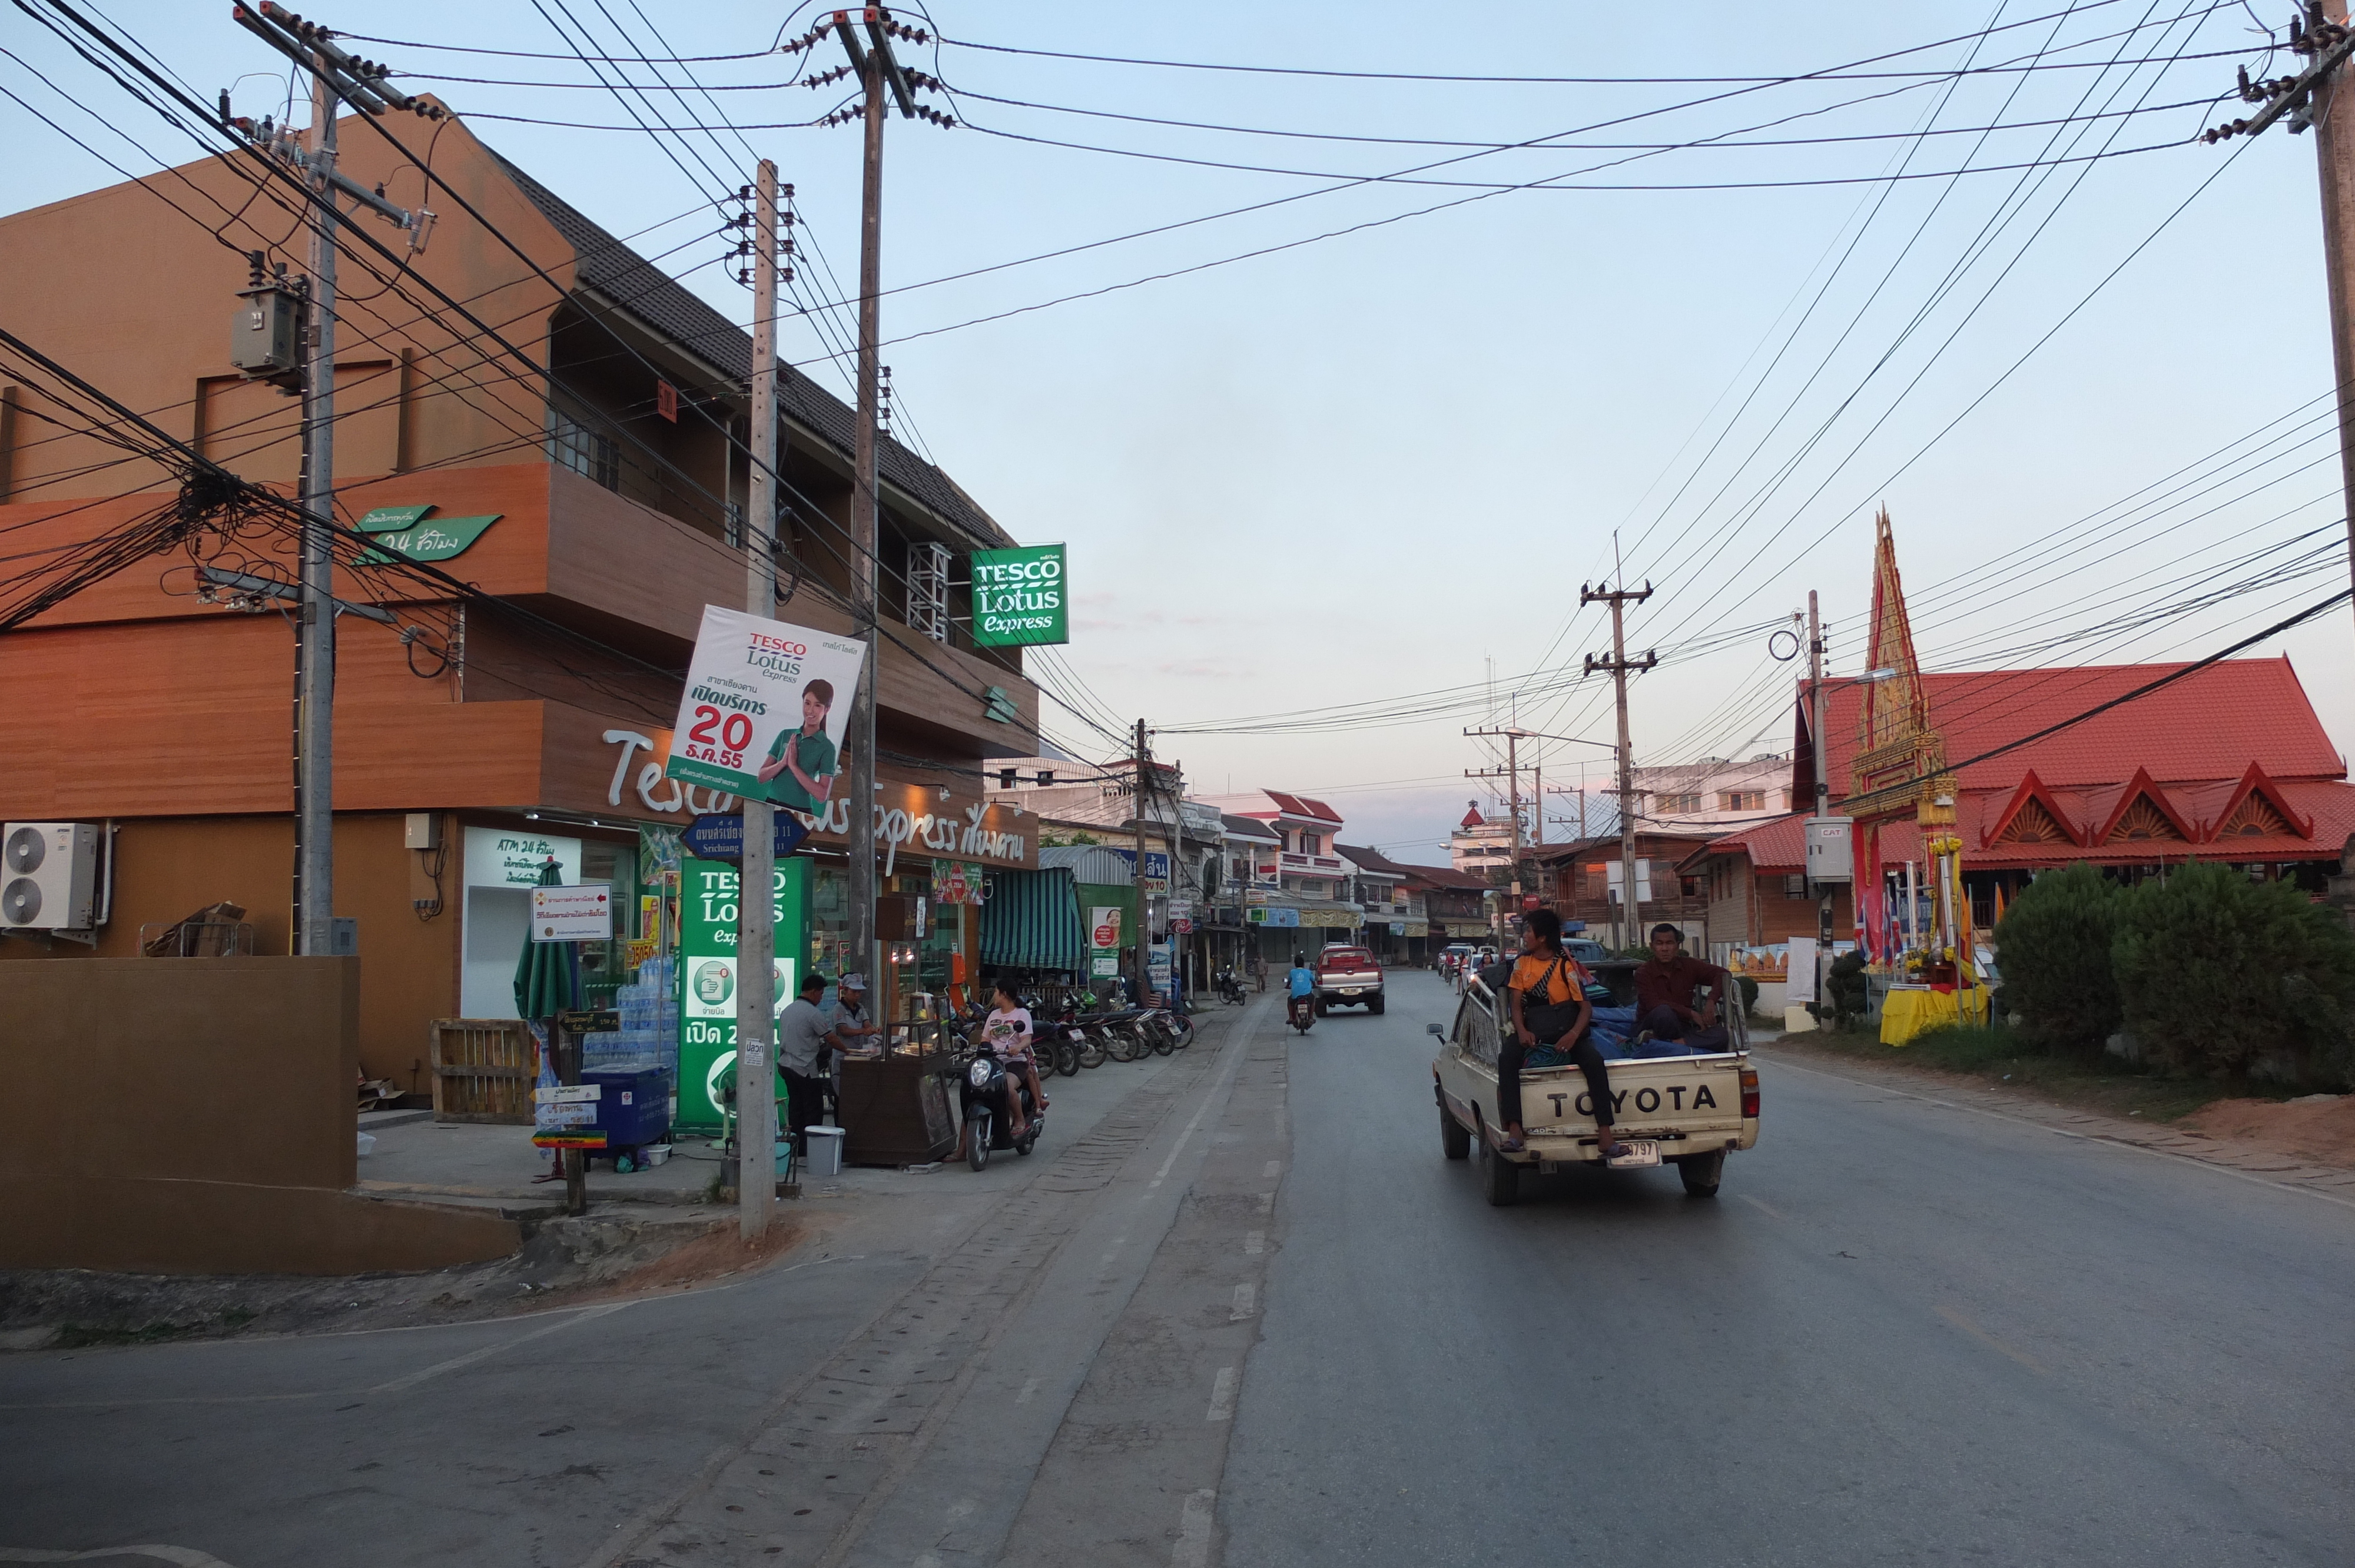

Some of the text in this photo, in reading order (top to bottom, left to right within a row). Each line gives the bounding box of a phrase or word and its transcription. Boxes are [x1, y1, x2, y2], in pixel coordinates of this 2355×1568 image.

[385, 528, 458, 552] 24 ชั่วโมง
[974, 560, 1060, 583] TESCO
[980, 589, 1060, 614] Lotus
[984, 616, 1053, 634] express
[750, 632, 807, 656] TESCO
[747, 650, 801, 676] Lotus
[706, 675, 758, 694] สาขาเชียงคาน
[762, 668, 797, 684] express
[691, 685, 767, 715] เปิดบริการ
[688, 705, 753, 752] 20
[782, 826, 792, 837] 11
[497, 839, 519, 852] ATM
[521, 841, 535, 853] 24
[703, 843, 739, 854] Srichiang
[700, 872, 786, 890] TEO
[1156, 881, 1165, 891] 10
[703, 899, 785, 923] Los
[702, 1006, 725, 1015] จ่ายบิล
[686, 1021, 721, 1044] เปิด
[747, 1041, 764, 1054] ปลวก
[1547, 1084, 1717, 1118] TOYOTA
